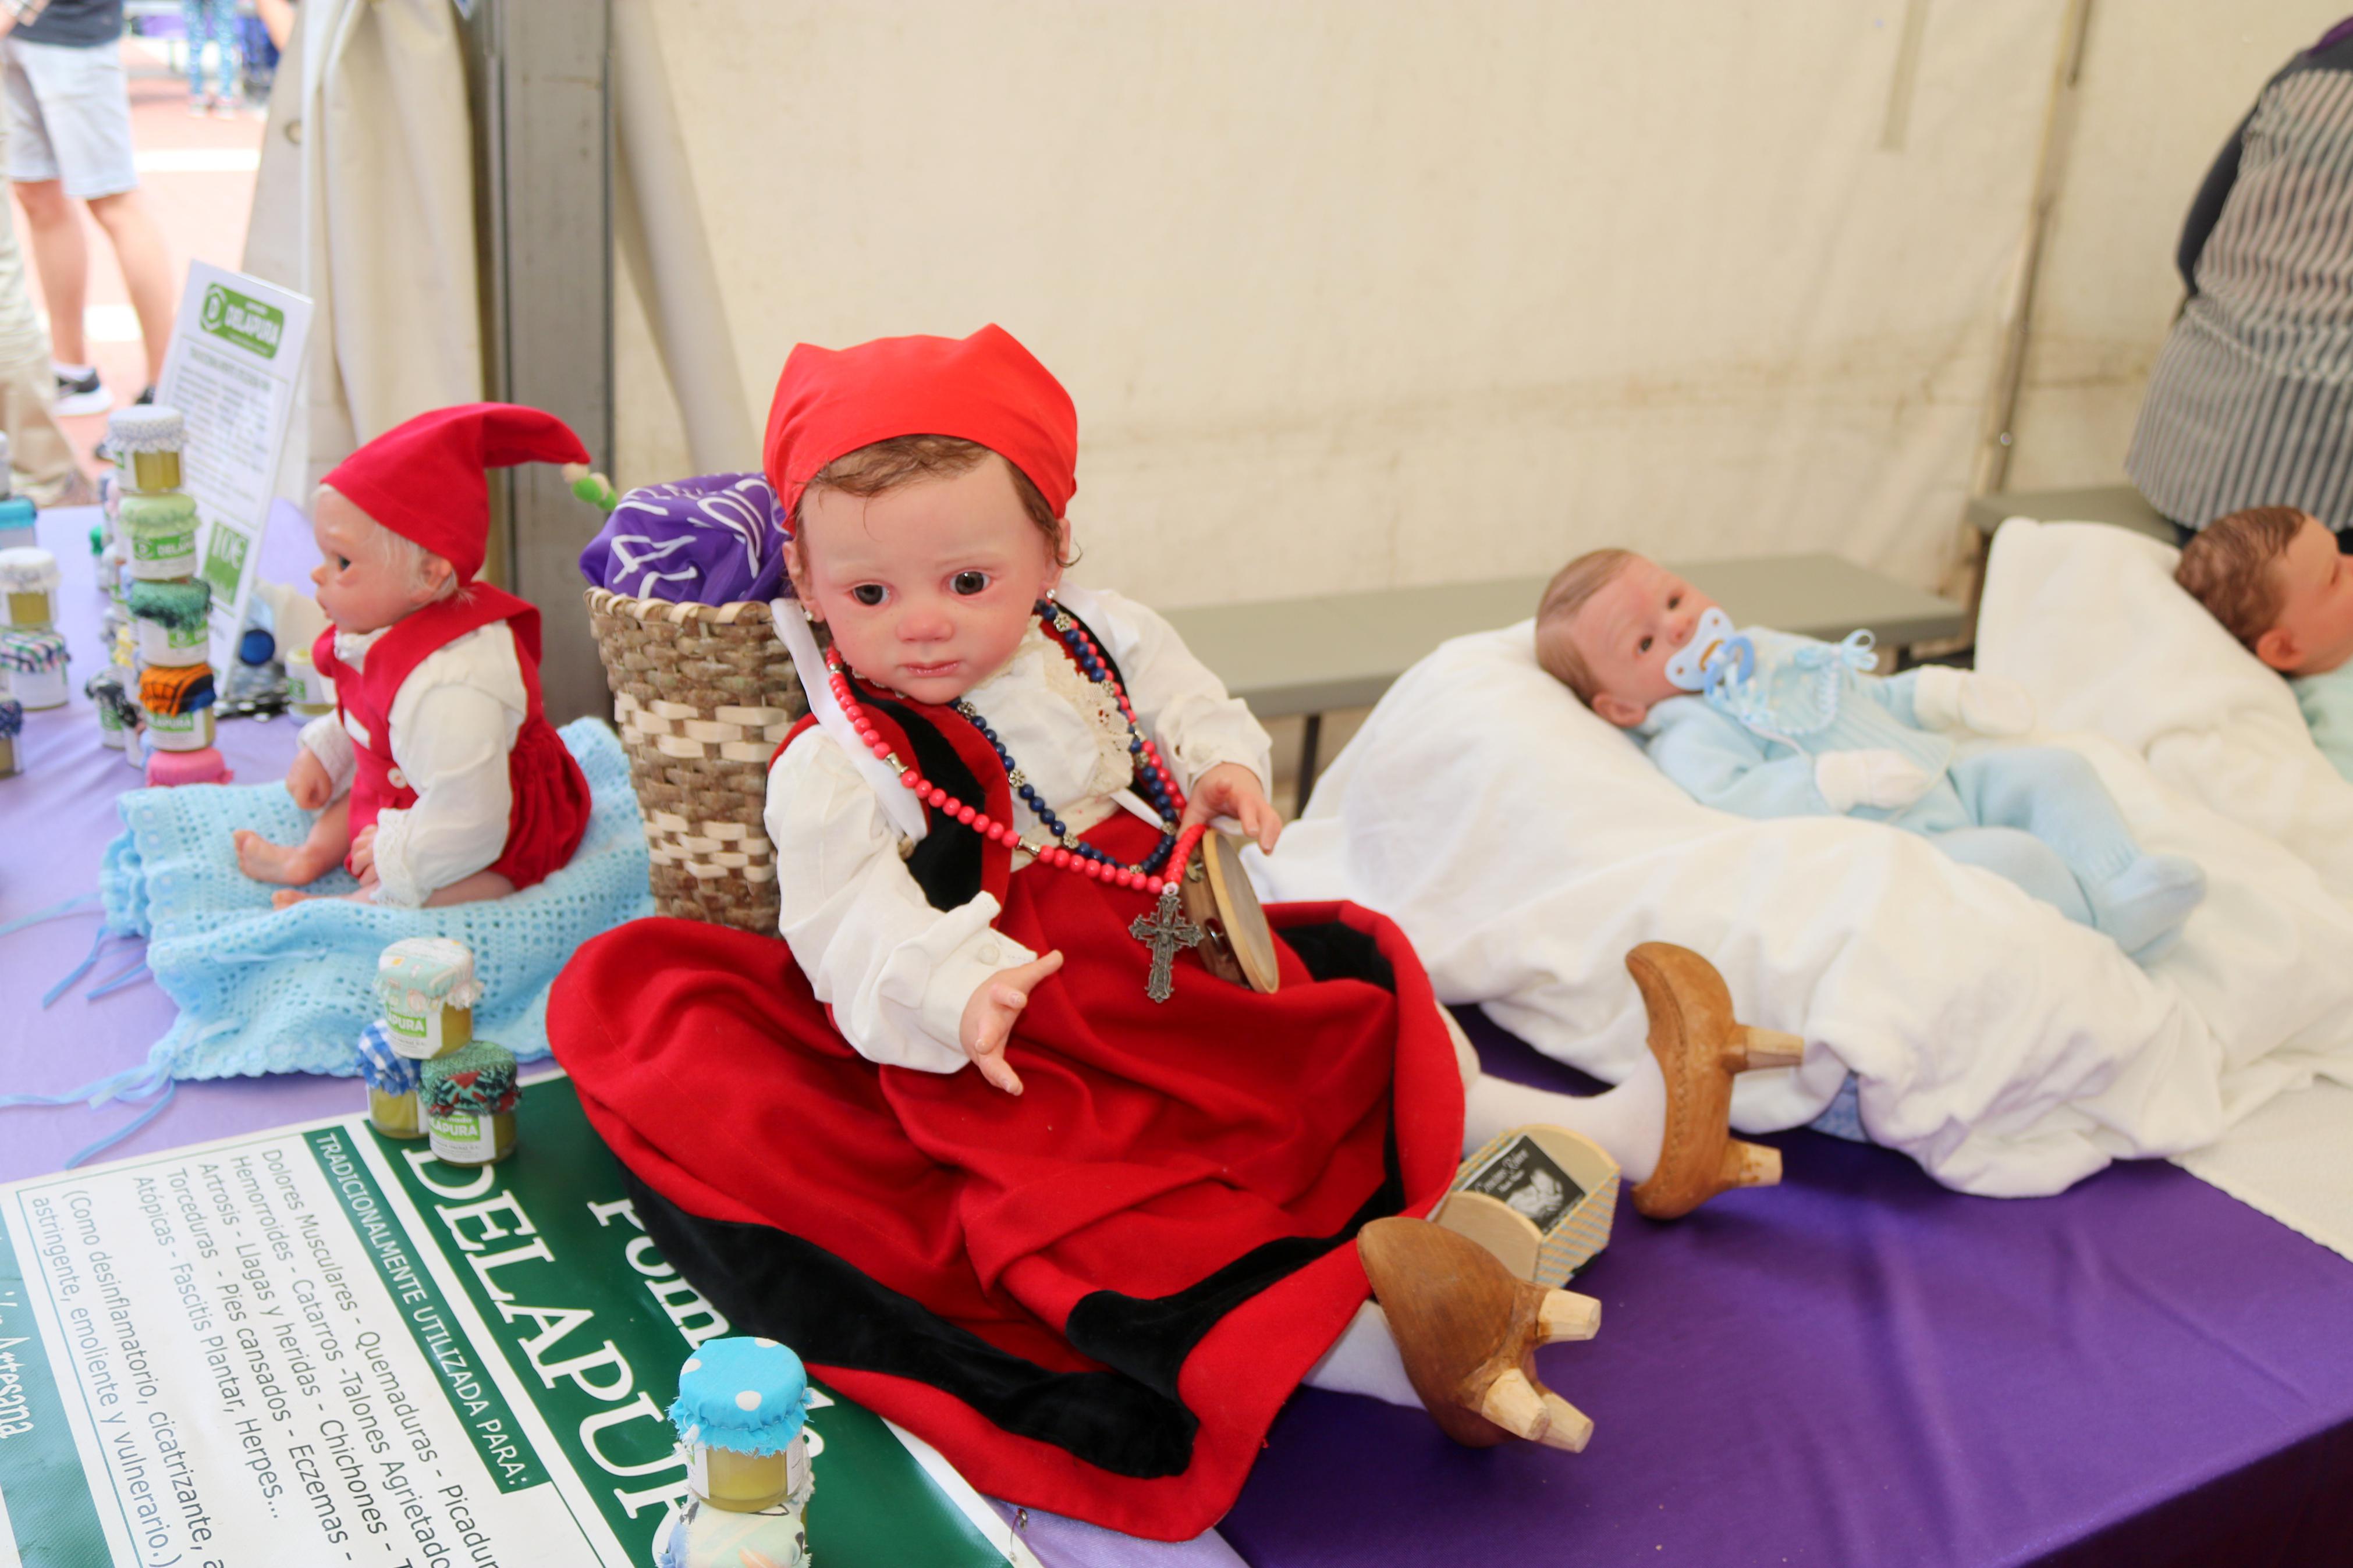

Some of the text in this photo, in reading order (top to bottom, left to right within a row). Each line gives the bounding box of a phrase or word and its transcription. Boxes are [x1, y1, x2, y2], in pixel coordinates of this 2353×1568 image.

[33, 1198, 182, 1567] astringente, emoliente y vulnerario.)
[62, 1190, 100, 1245] (Como
[89, 1251, 157, 1404] desinflamatorio,
[148, 1412, 212, 1550] cicatrizante,
[133, 1178, 175, 1246] Atópicas
[171, 1263, 212, 1331] Fascitis
[200, 1336, 246, 1412] Plantar,
[235, 1418, 283, 1518] Herpes...
[168, 1168, 218, 1258] Torceduras
[217, 1283, 247, 1321] Pies
[236, 1328, 292, 1421] cansados
[288, 1444, 349, 1544] Eczemas
[198, 1165, 240, 1225] Artrosis
[236, 1243, 275, 1300] Llagas
[260, 1306, 284, 1315] y
[273, 1322, 321, 1396] heridas
[320, 1420, 388, 1534] Chichones
[231, 1156, 293, 1261] Hemorroides
[292, 1279, 343, 1361] Catarros
[262, 1149, 304, 1210] Dolores
[295, 1214, 357, 1311] Musculares
[355, 1332, 438, 1462] Quemaduras
[316, 1132, 527, 1485] TRADICIONALMENTE UTILIZADA PARA:
